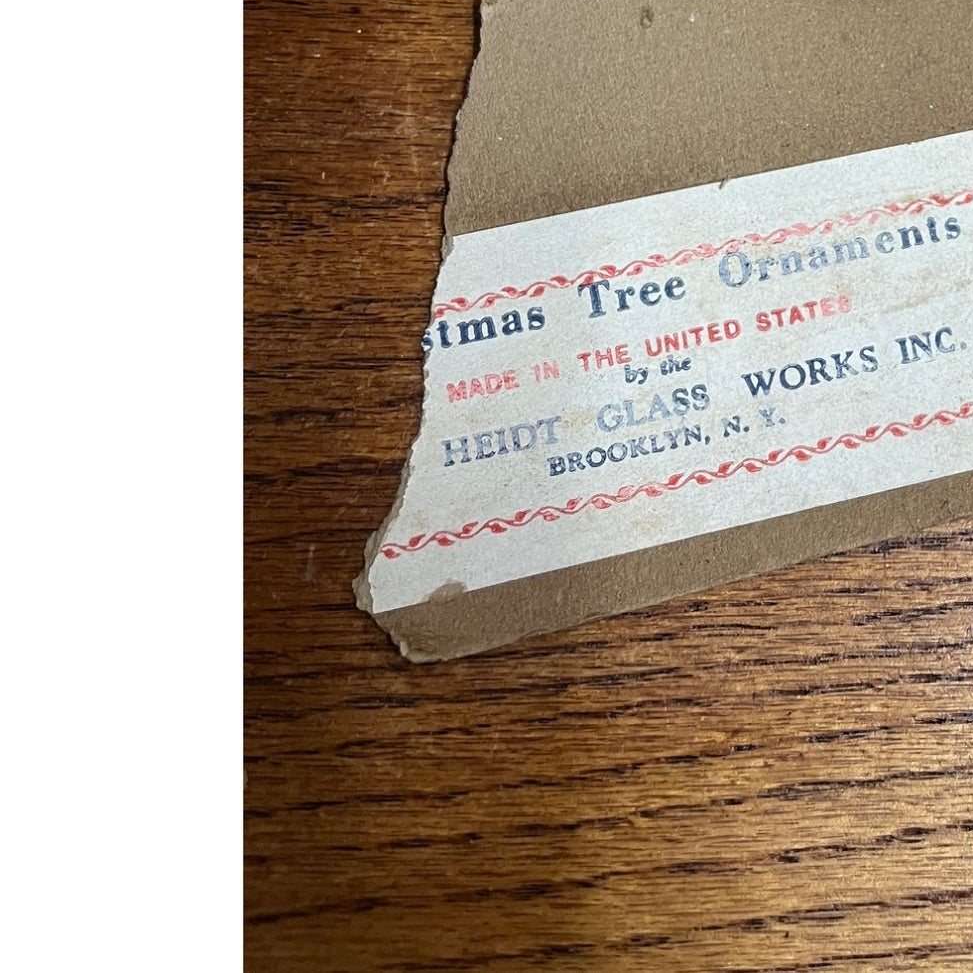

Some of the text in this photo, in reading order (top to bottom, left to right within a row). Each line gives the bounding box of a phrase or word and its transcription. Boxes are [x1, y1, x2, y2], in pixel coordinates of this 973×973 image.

[577, 277, 687, 318] Tree
[718, 217, 961, 287] Ornaments
[441, 327, 967, 466] HEIDT GLASS WORKS INC.
[446, 295, 852, 402] MADE IN THE UNITED STATES
[624, 355, 692, 385] by the
[547, 407, 786, 477] BROOKLYN, N. Y.
